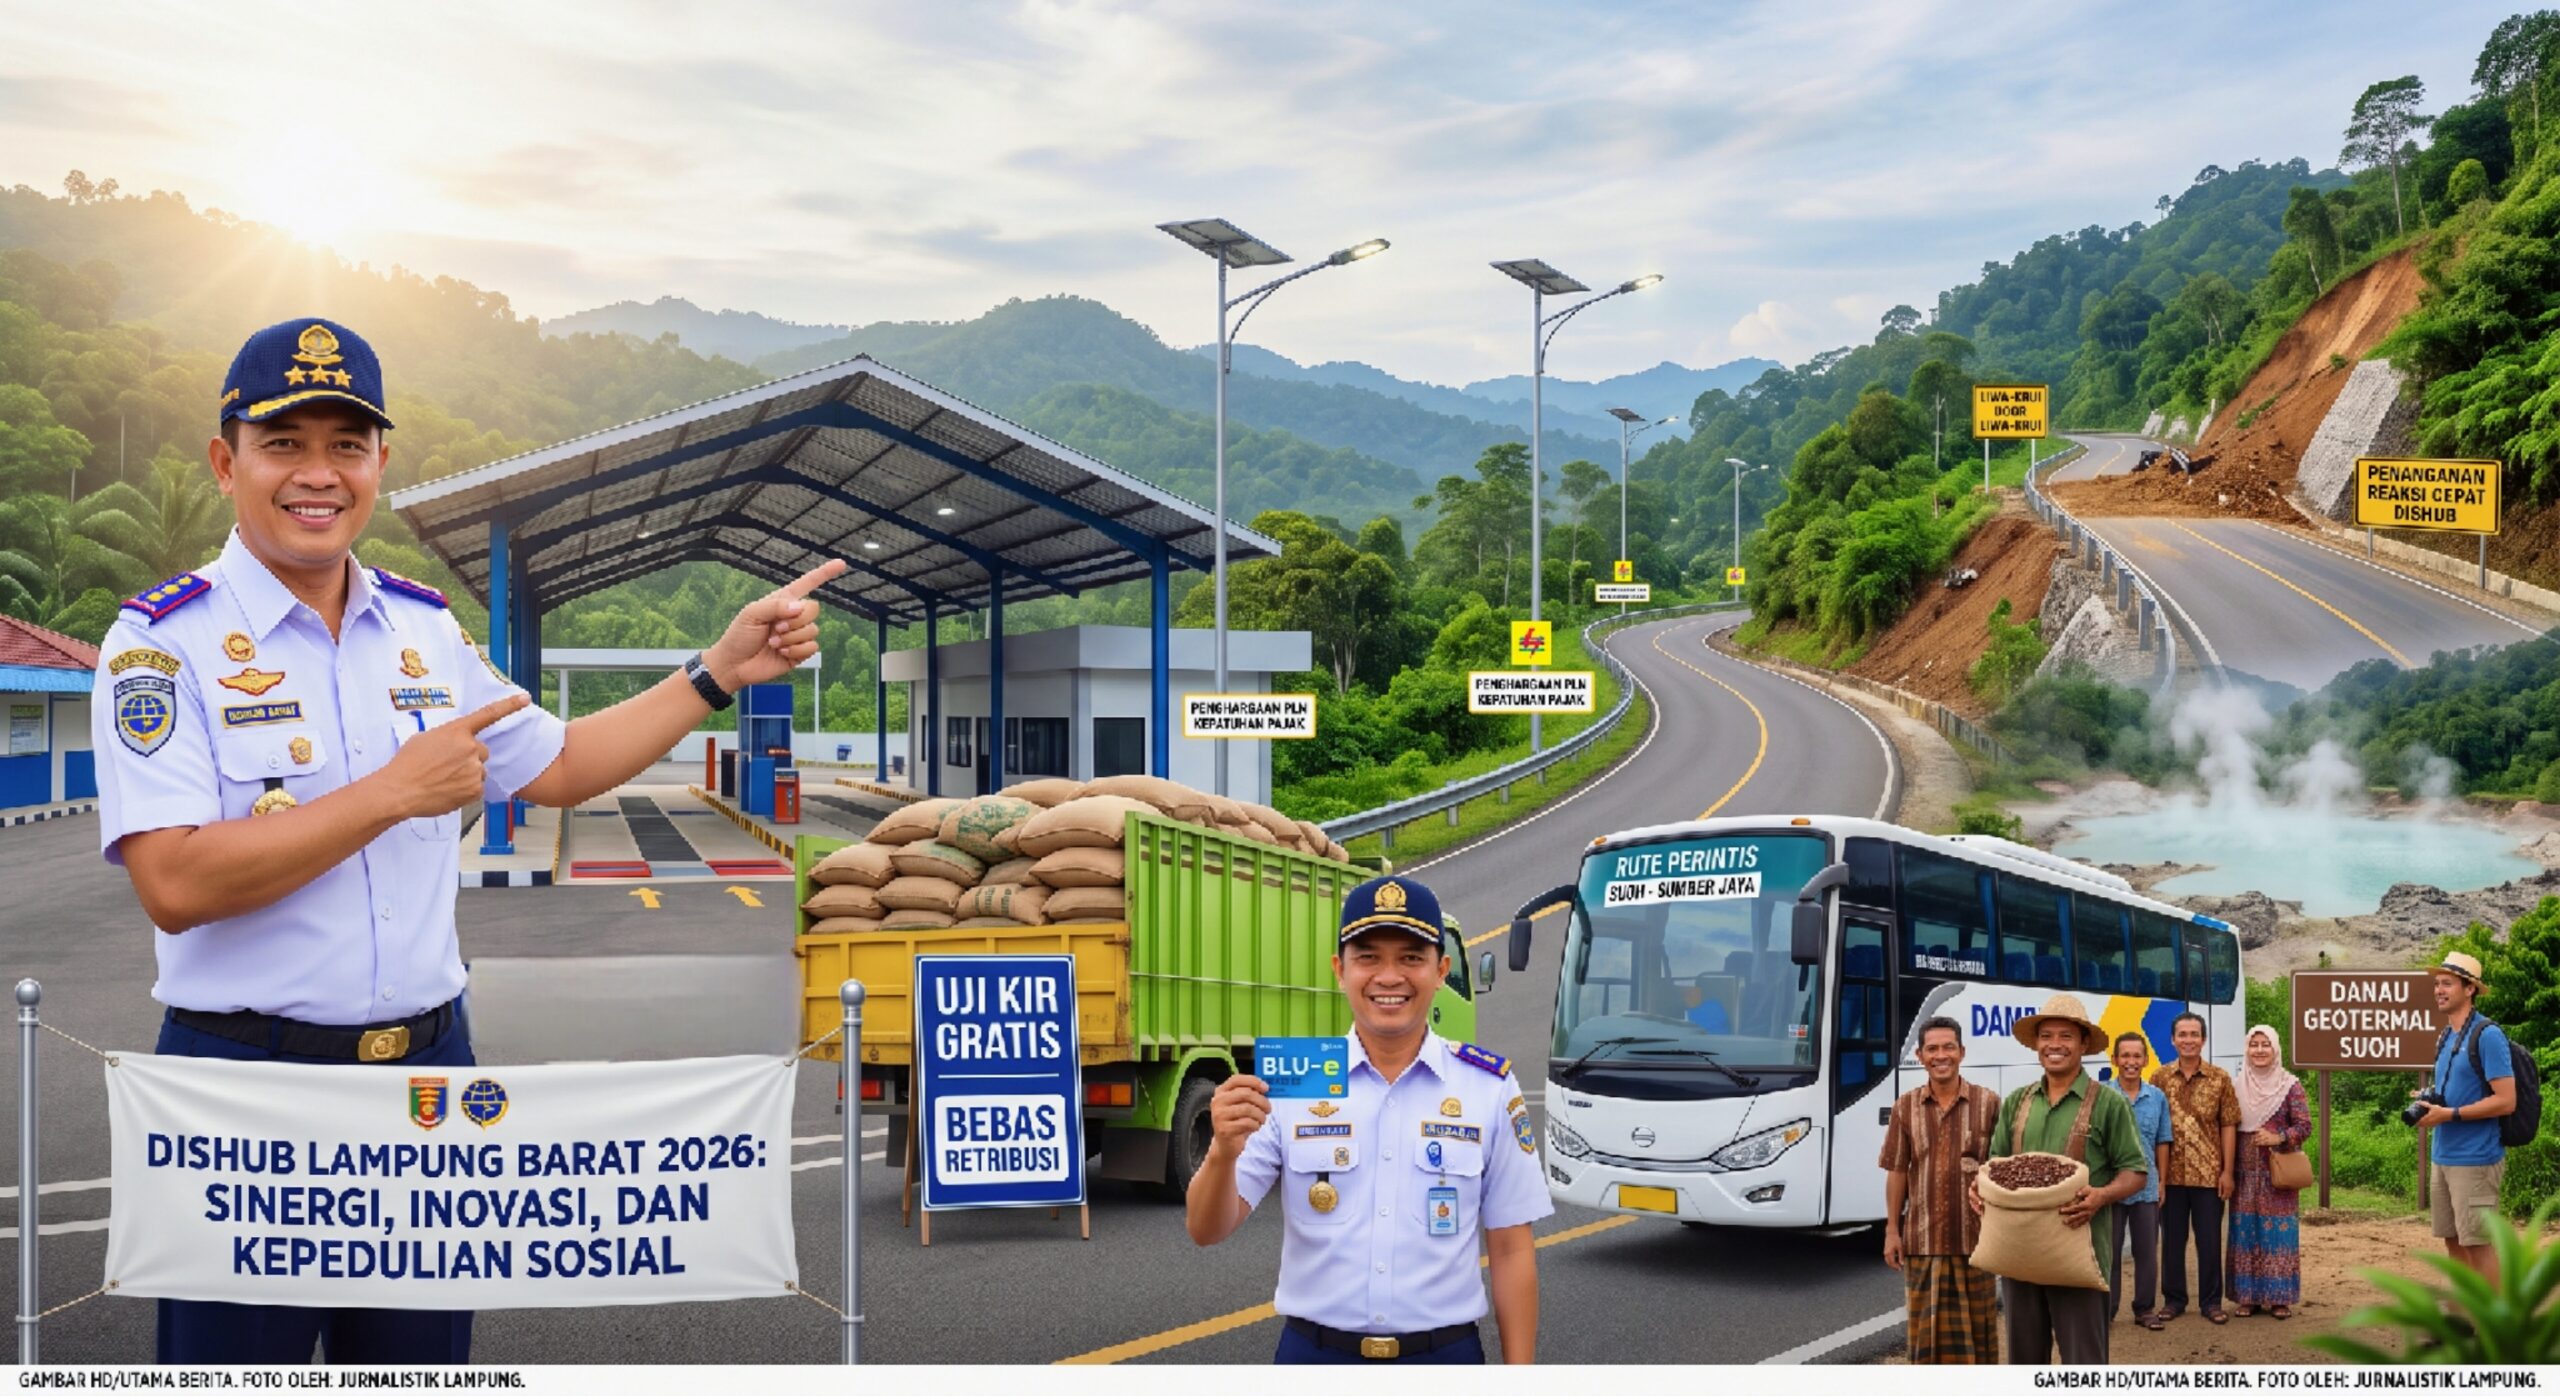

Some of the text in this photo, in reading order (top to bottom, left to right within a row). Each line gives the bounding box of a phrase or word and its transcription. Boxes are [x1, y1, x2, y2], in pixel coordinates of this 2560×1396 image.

[1981, 391, 2042, 402] LIWA-KRUI
[1981, 420, 2042, 431] LIWA-KRUI
[2368, 465, 2485, 485] PENANGANAN
[2368, 485, 2485, 505] REAKSI CEPAT
[2394, 505, 2457, 522] DISHUB
[1476, 678, 1586, 690] PENGHARGAAN PLN
[1191, 702, 1307, 715] PENGHARGAAN PLN
[1478, 694, 1585, 706] KEPATUHAN PAJAK
[1194, 717, 1306, 730] KEPATUHAN PAJAK
[1615, 845, 1759, 878] RUTE PERINTIS
[1608, 884, 1646, 902] SUOH
[1658, 879, 1715, 899] SUMBER
[1718, 877, 1755, 896] JAYA
[935, 976, 1059, 1015] UJI KIR
[2331, 981, 2409, 1003] DANAU
[2304, 1008, 2436, 1031] GEOTERMAL
[936, 1021, 1061, 1060] GRATIS
[2340, 1036, 2400, 1058] SUOH
[1262, 1057, 1340, 1076] BLU-e
[946, 1105, 1056, 1142] BEBAS
[148, 1132, 766, 1178] DISHUB LAMPUNG BARAT 2026:
[945, 1147, 1060, 1172] RETRIBUSI
[204, 1182, 709, 1236] SINERGI, INOVASI, DAN
[233, 1236, 685, 1280] KEPEDULIAN SOSIAL
